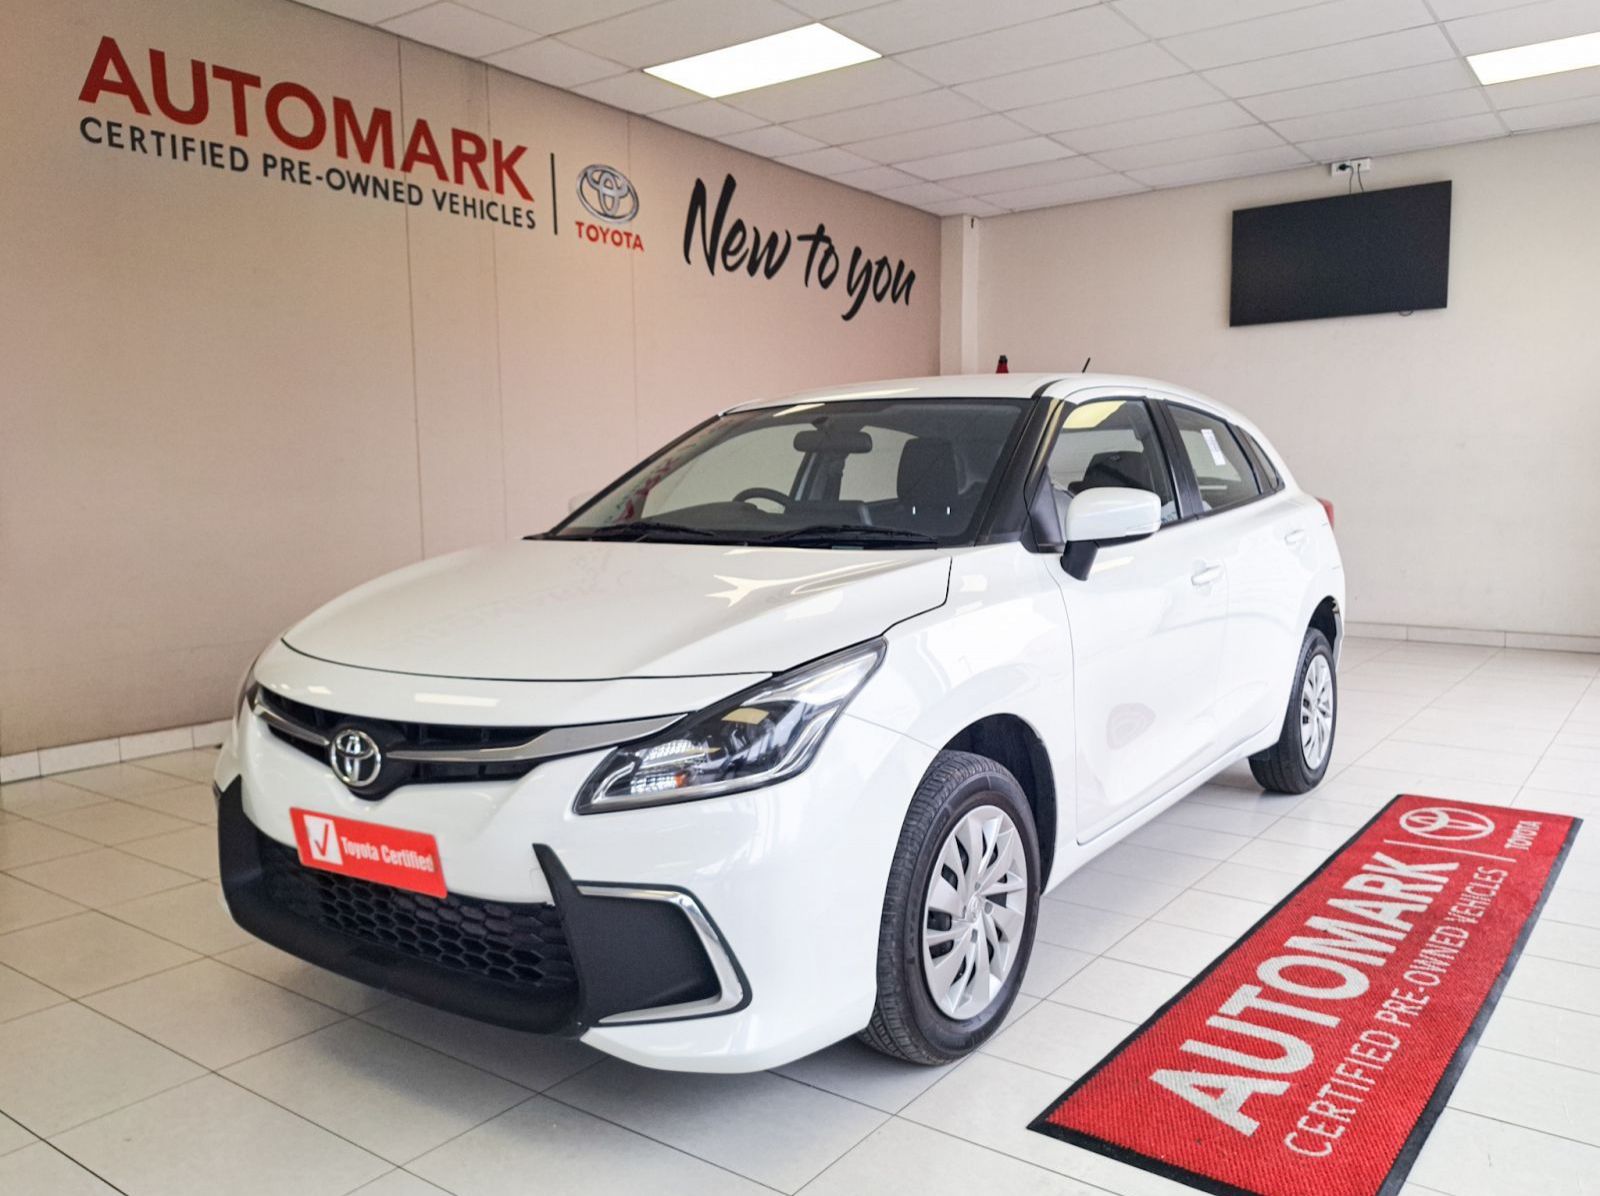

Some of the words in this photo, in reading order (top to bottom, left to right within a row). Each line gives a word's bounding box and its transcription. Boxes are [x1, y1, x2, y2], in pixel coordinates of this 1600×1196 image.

[78, 36, 534, 201] AUTOMARK
[80, 117, 249, 172] CERTIFIED
[262, 153, 423, 206] PRE-OWNED
[432, 188, 536, 230] VEHICLES
[575, 220, 645, 252] TOYOTA
[683, 174, 791, 280] New
[797, 223, 839, 289] to
[841, 246, 916, 321] you
[340, 836, 380, 862] Toyota
[380, 844, 436, 873] Certified
[1504, 820, 1542, 850] TOYOTA
[1148, 851, 1460, 1137] AUTOMARK
[1284, 1029, 1400, 1157] CERTIFIED
[1374, 925, 1470, 1027] PRE-OWNED
[1444, 865, 1509, 924] VEHICLES
